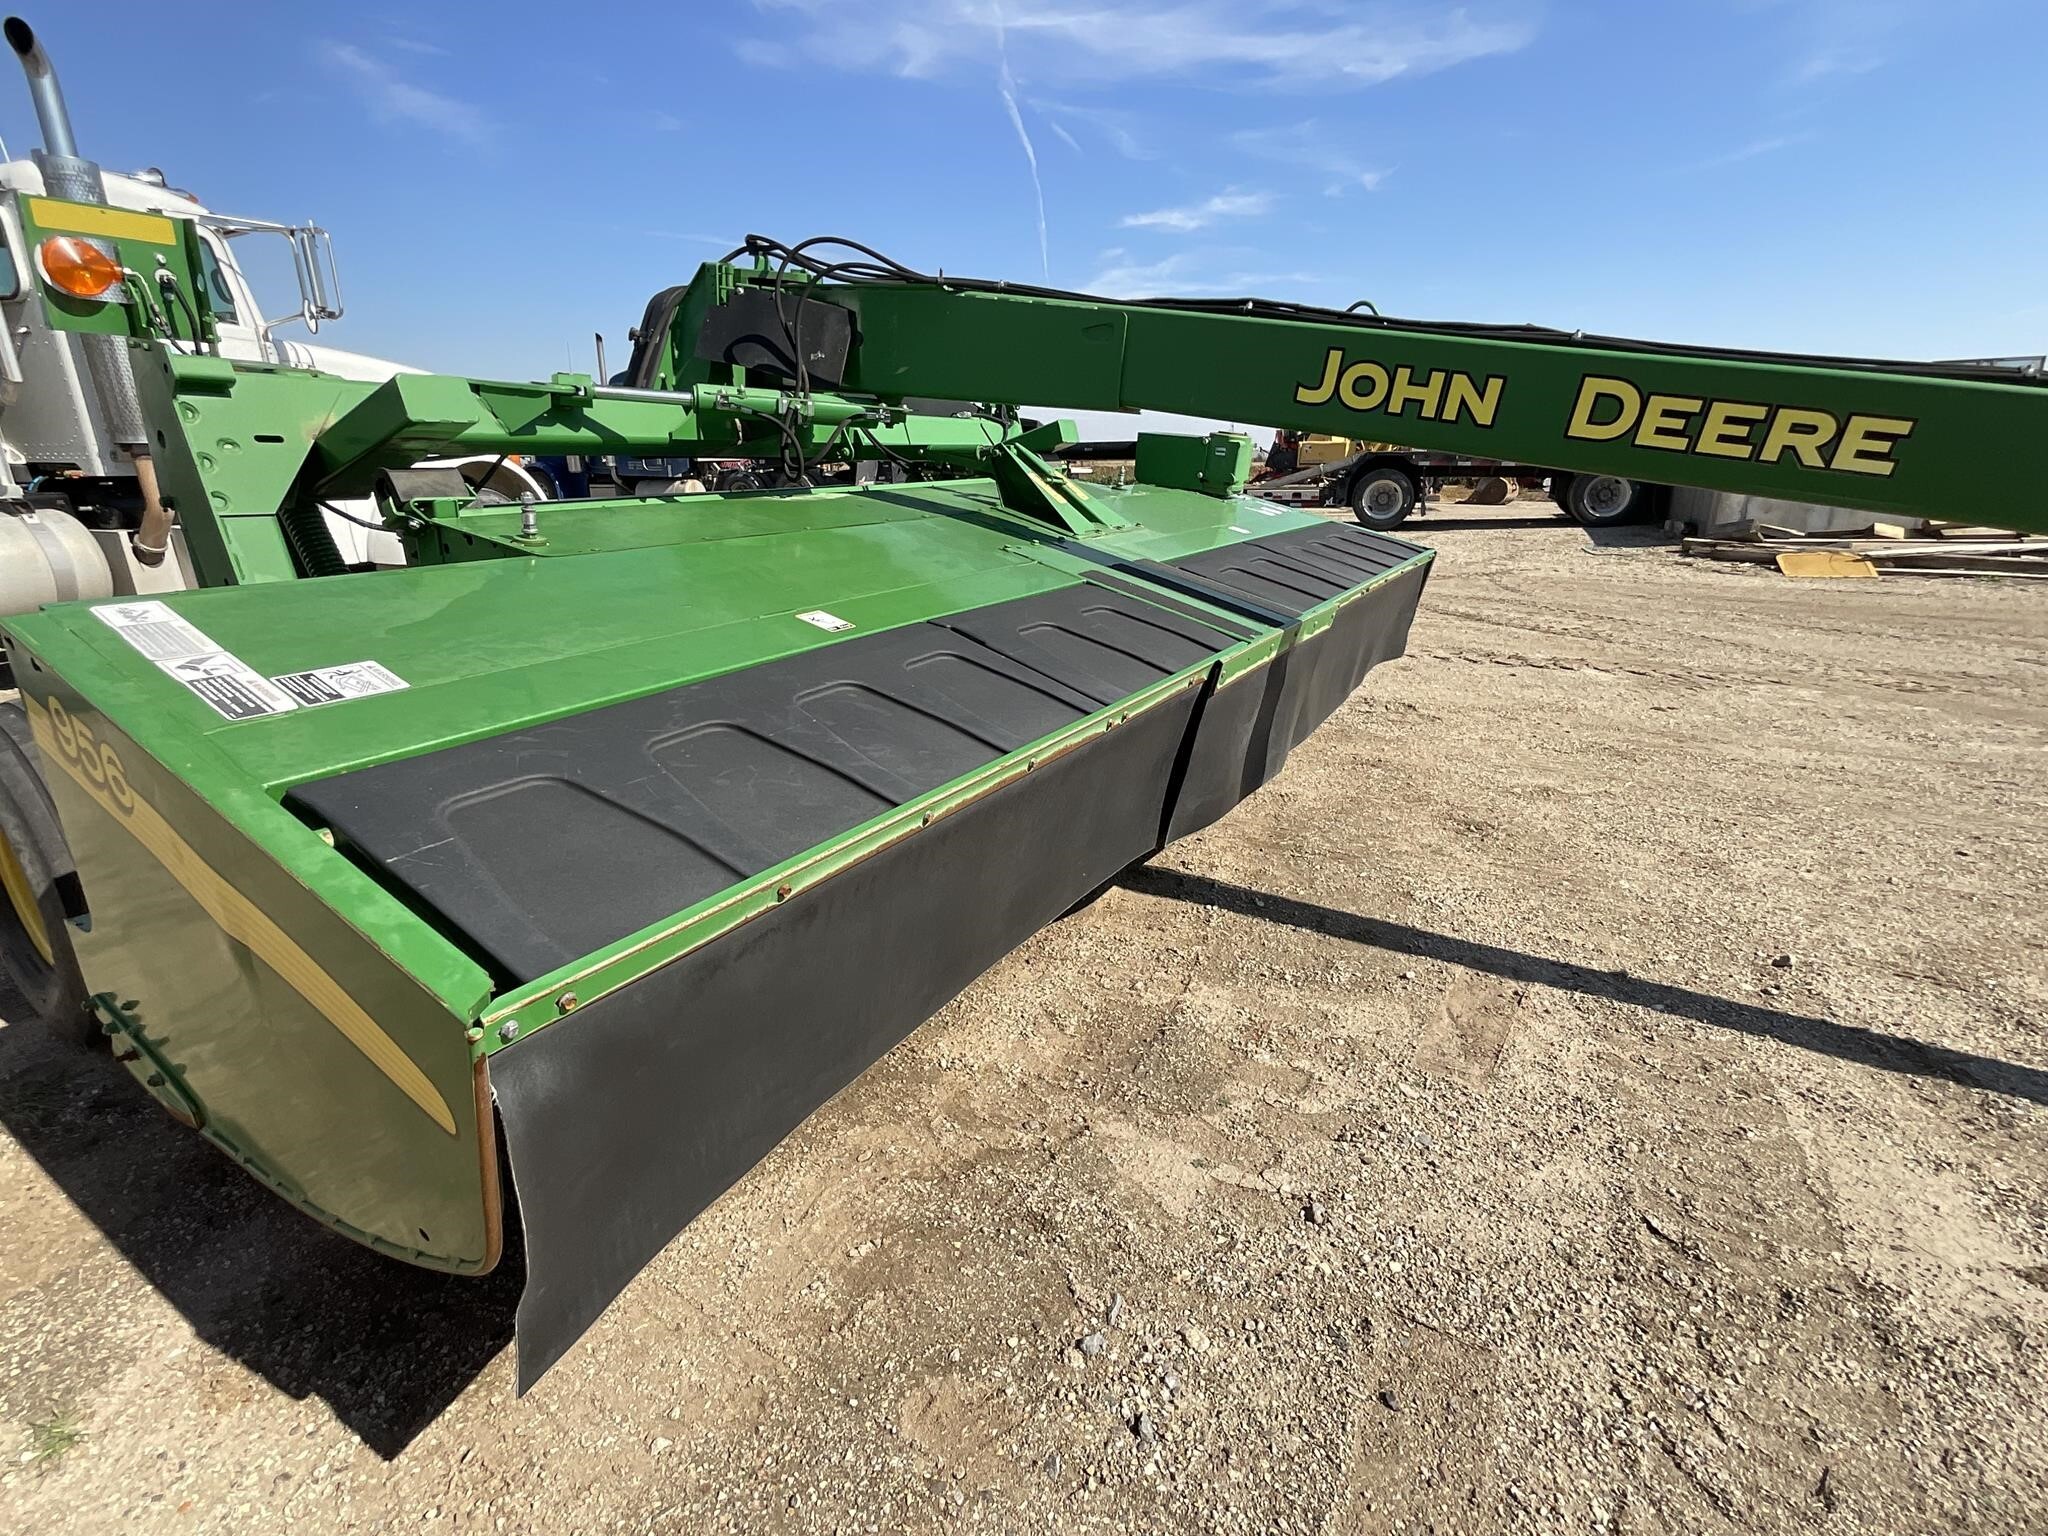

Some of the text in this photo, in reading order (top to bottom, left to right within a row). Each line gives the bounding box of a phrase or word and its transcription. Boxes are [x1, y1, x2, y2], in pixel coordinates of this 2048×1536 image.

[1295, 347, 1917, 477] JOHN DEERE
[47, 695, 134, 812] 956
